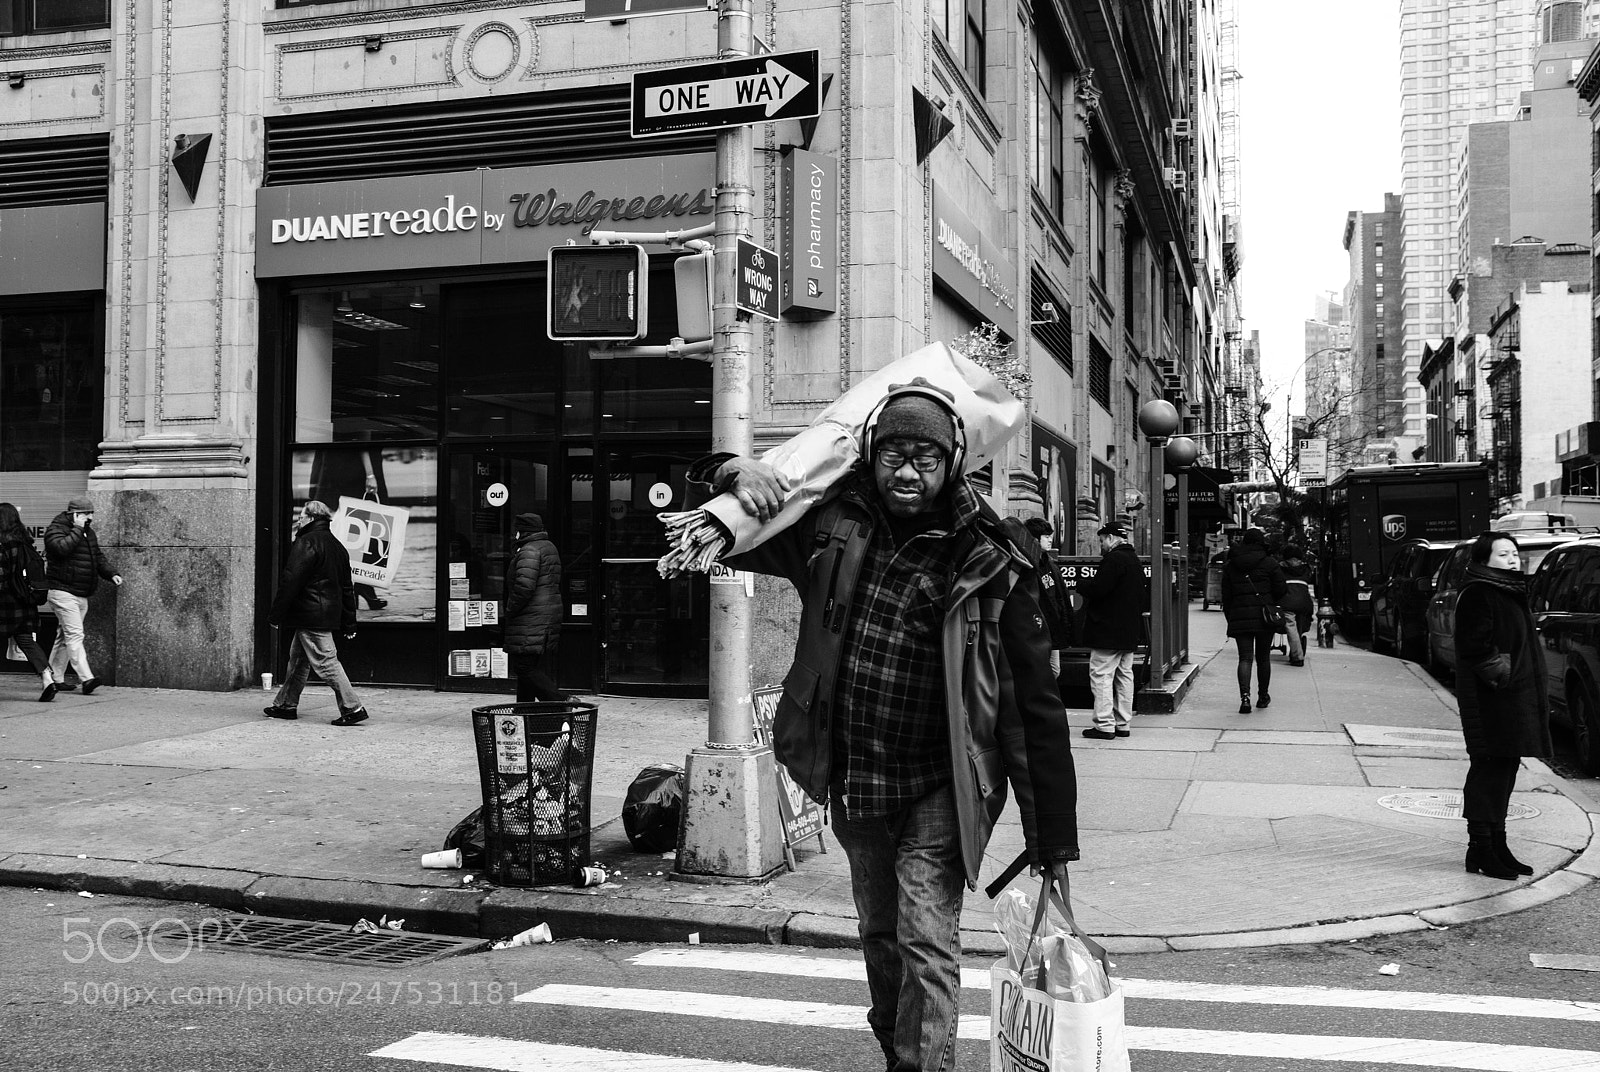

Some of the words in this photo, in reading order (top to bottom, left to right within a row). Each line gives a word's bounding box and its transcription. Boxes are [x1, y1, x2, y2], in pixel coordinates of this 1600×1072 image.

[659, 84, 710, 113] ONE
[735, 74, 790, 105] WAY
[484, 211, 505, 231] by
[510, 187, 715, 236] Walgreens
[807, 163, 825, 269] pharmacy
[744, 266, 773, 292] WRONG
[749, 287, 767, 308] WAY
[490, 491, 504, 499] out
[656, 490, 665, 499] in
[1384, 521, 1405, 537] ups
[1060, 566, 1077, 578] 28
[475, 660, 488, 668] 24
[499, 764, 512, 772] $100
[513, 764, 527, 772] FINE
